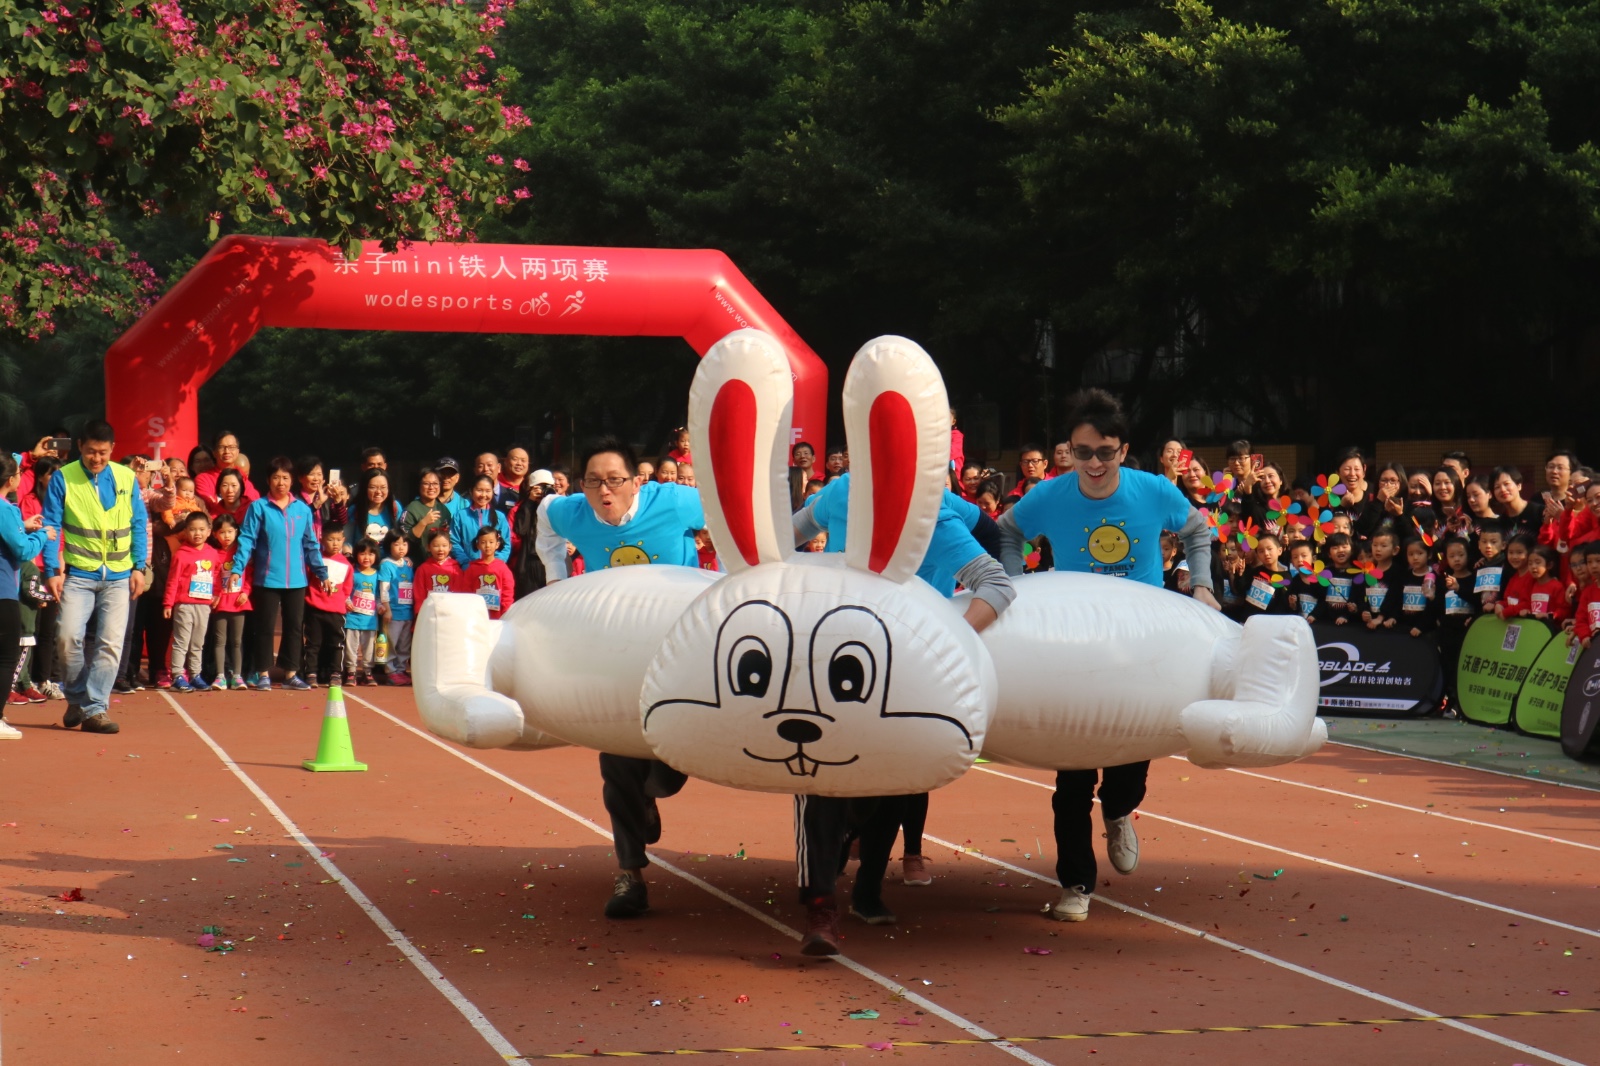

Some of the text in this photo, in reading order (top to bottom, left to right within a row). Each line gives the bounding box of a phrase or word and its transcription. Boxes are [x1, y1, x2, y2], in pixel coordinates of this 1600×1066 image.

[364, 290, 512, 311] wodesports
[1478, 574, 1496, 585] 196
[1249, 586, 1267, 602] 194
[1330, 586, 1347, 597] 191
[355, 597, 373, 610] 165
[1405, 594, 1421, 605] 207
